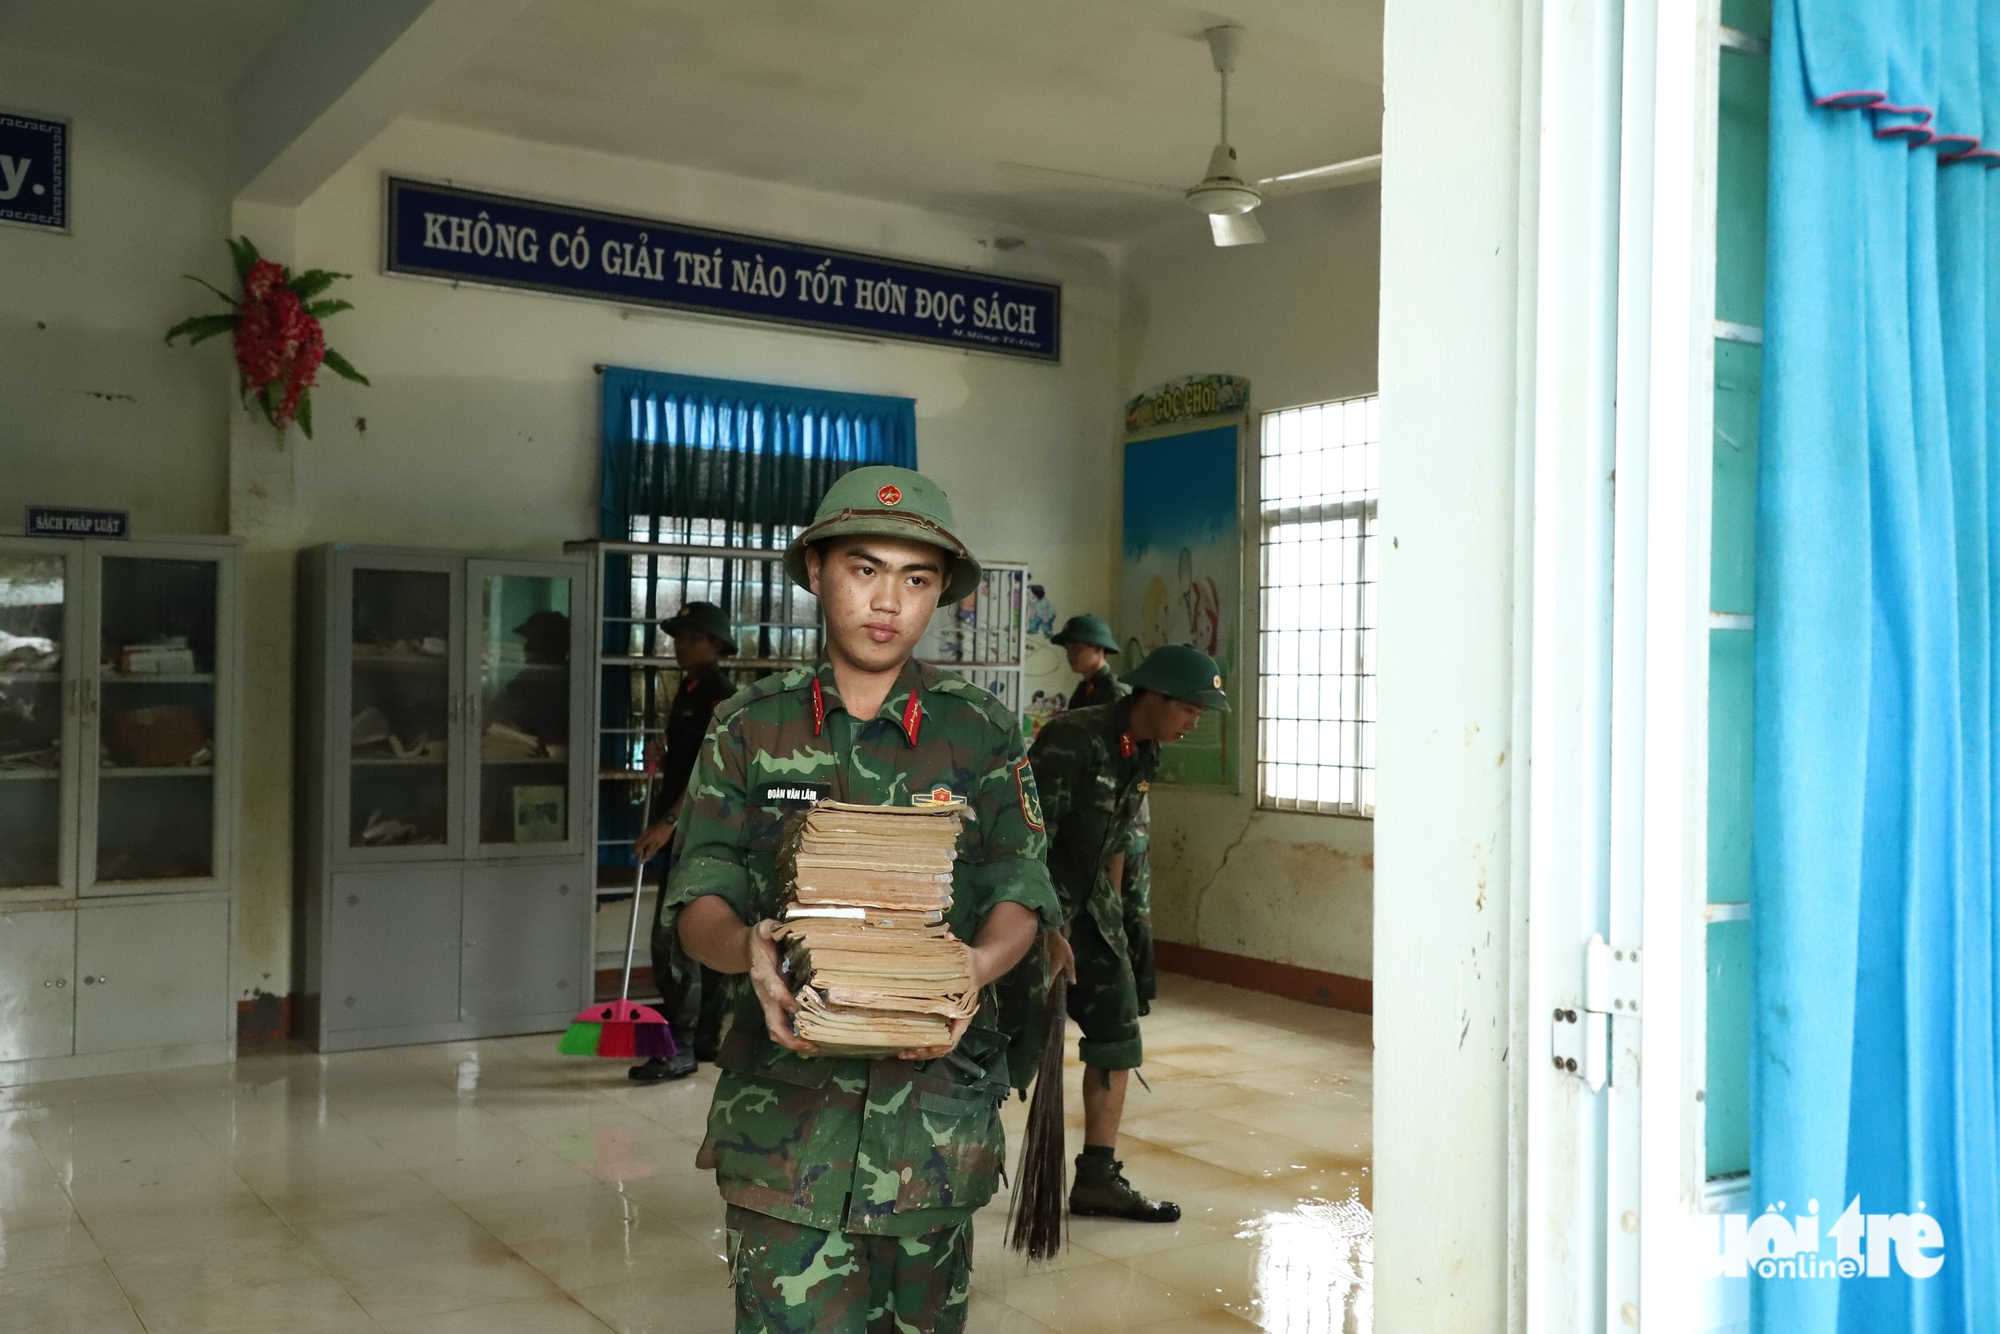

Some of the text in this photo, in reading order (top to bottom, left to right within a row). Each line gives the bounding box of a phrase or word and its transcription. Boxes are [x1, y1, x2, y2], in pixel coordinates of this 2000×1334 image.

[423, 211, 1036, 334] KHÔNG CÓ GIẢI TRÍ NÀO TỐT HƠN ĐỌC SÁCH
[36, 512, 120, 535] SÁCH PHÁP LUẬT
[786, 788, 800, 800] VĂN
[801, 788, 817, 800] LÂM
